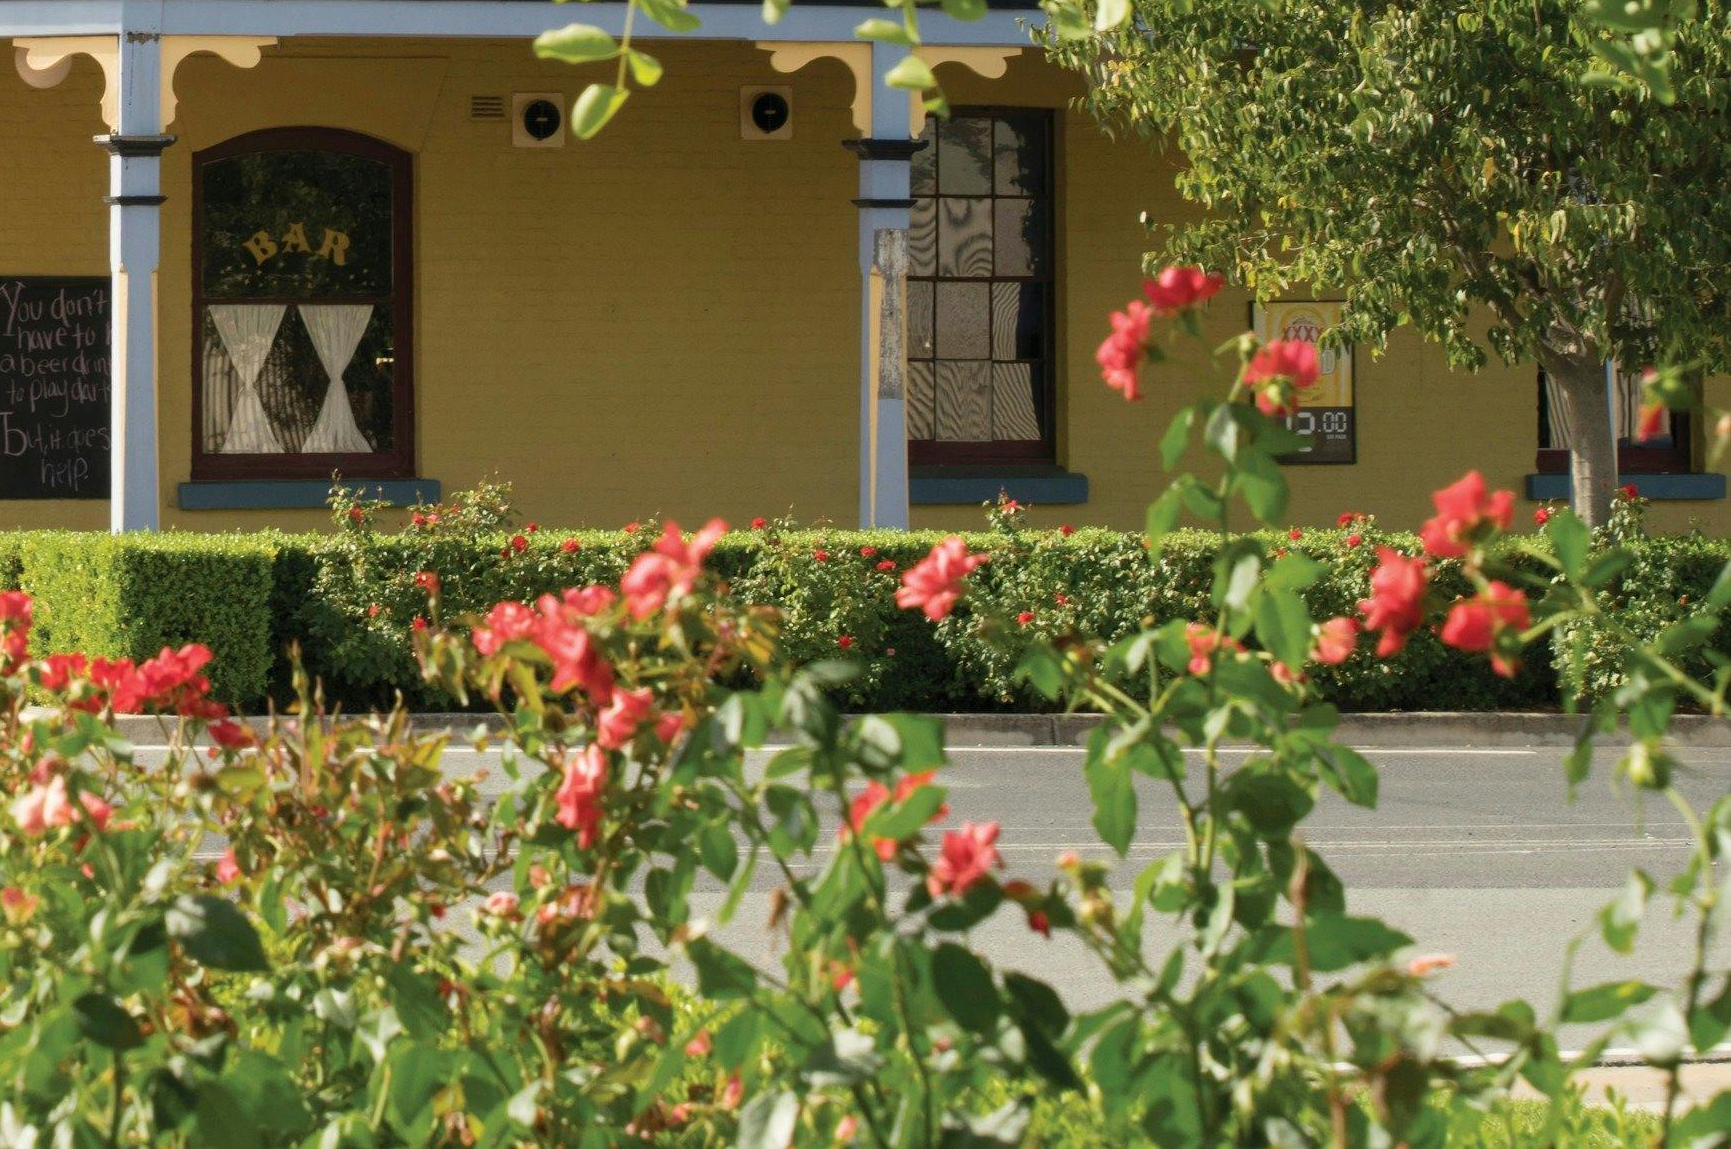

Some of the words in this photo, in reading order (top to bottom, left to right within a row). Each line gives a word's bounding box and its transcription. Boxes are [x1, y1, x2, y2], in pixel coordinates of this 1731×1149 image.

[242, 221, 351, 267] BAR
[51, 288, 109, 326] don't
[17, 323, 68, 353] have
[72, 325, 96, 350] to
[0, 355, 15, 373] a
[21, 354, 66, 375] beer
[7, 378, 24, 405] to
[30, 379, 68, 417] play
